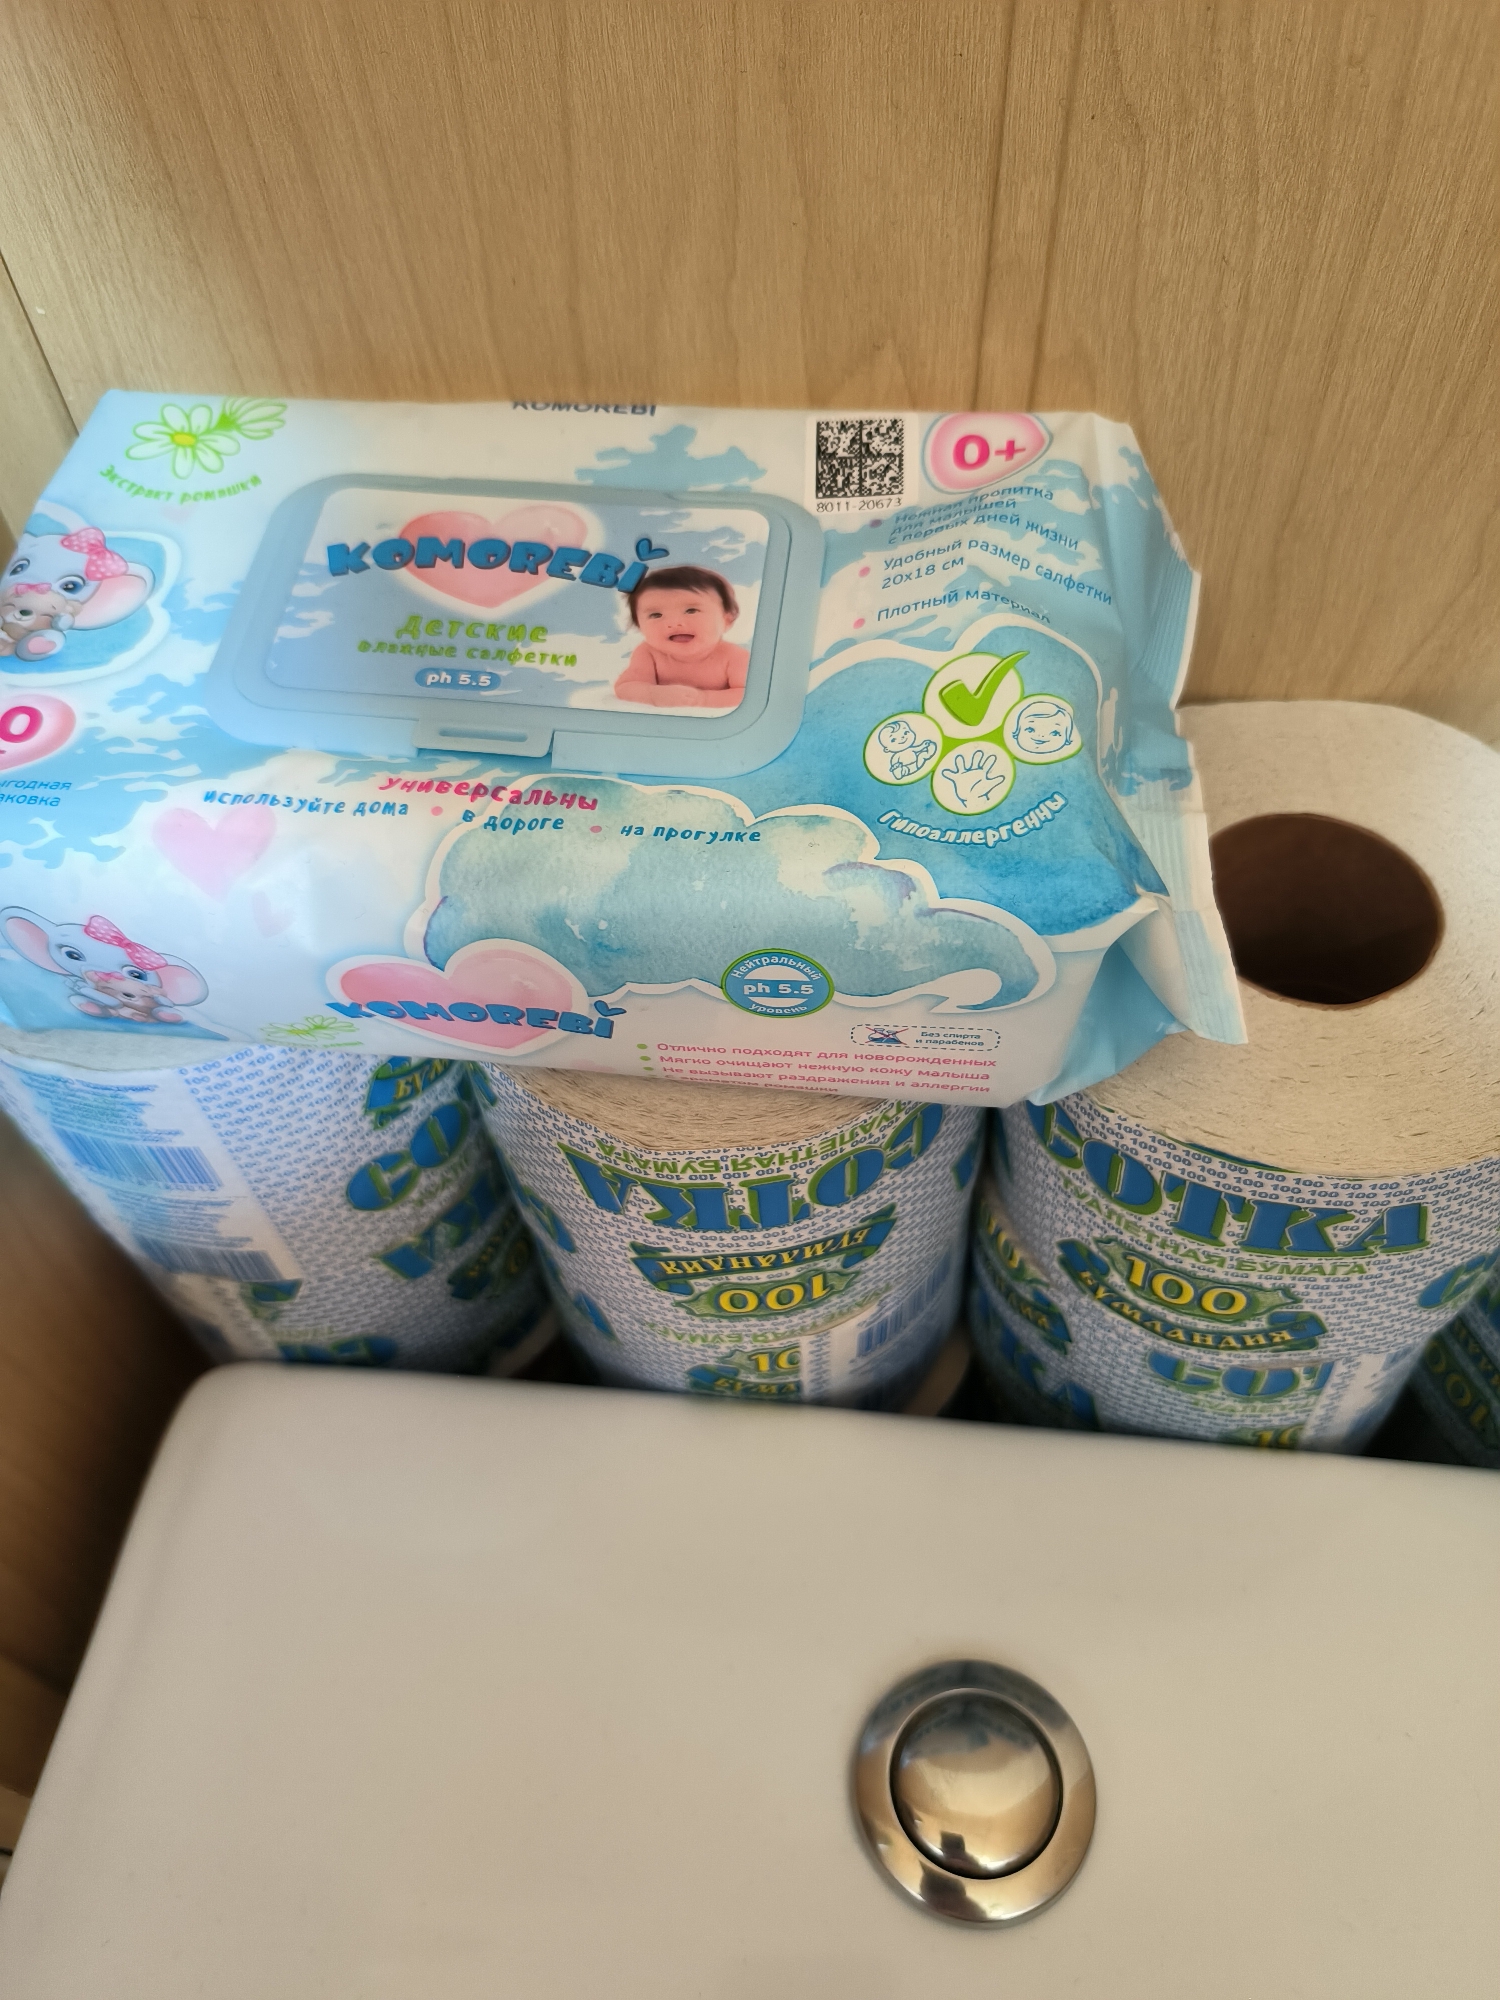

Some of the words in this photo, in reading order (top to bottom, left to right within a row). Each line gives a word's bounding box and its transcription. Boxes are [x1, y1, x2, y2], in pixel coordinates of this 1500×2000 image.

[952, 434, 1027, 471] 0+
[815, 497, 903, 513] 8011-20673
[967, 485, 1054, 504] пропитка
[888, 536, 898, 545] с
[901, 518, 969, 543] первых
[973, 512, 1020, 527] дней
[1025, 519, 1080, 551] жизни
[890, 521, 924, 537] для
[928, 499, 1018, 526] малышей
[883, 539, 963, 571] Удобный
[967, 539, 1031, 572] размер
[1034, 563, 1113, 606] салфетки
[941, 556, 965, 572] см
[876, 588, 960, 622] Плотный
[964, 589, 1051, 624] материал
[395, 614, 550, 644] Детские
[357, 639, 458, 659] влажные
[465, 646, 578, 668] салфетки
[425, 671, 452, 687] ph
[457, 672, 492, 687] 5.5
[353, 801, 409, 817] дома
[462, 809, 476, 823] в
[483, 815, 565, 836] дороге
[877, 791, 1068, 848] Гипоаллергенны
[620, 824, 645, 837] на
[652, 827, 762, 845] прогулке
[731, 955, 824, 981] Нейтральный
[743, 983, 771, 996] ph
[777, 984, 814, 995] 5.5
[749, 1003, 808, 1014] уровень
[925, 1038, 985, 1047] парабенов
[942, 1032, 981, 1040] спирта
[656, 1043, 728, 1054] Отлично
[732, 1048, 813, 1058] подходят
[816, 1051, 849, 1060] для
[854, 1053, 998, 1068] новорожденных
[659, 1056, 712, 1065] Мягко
[715, 1059, 794, 1069] очищают
[798, 1062, 865, 1074] нежную
[869, 1066, 913, 1077] кожу
[917, 1070, 991, 1081] малыша
[662, 1066, 684, 1074] Не
[688, 1069, 774, 1079] вызывают
[778, 1074, 891, 1087] раздражения
[910, 1081, 992, 1093] аллергии
[731, 1098, 907, 1172] ТУАЛЕТНАЯ
[557, 1102, 943, 1231] СОТКА
[595, 1137, 722, 1175] БУМАГА
[1026, 1100, 1430, 1258] СОТКА
[1063, 1177, 1227, 1268] ТУАЛЕТНАЯ
[1235, 1260, 1368, 1276] БУМАГА
[658, 1227, 868, 1278] БУМЛАНДИЯ
[719, 1274, 832, 1313] 100
[1125, 1254, 1249, 1316] 100
[1078, 1270, 1295, 1349] БУМЛАНДИЯ
